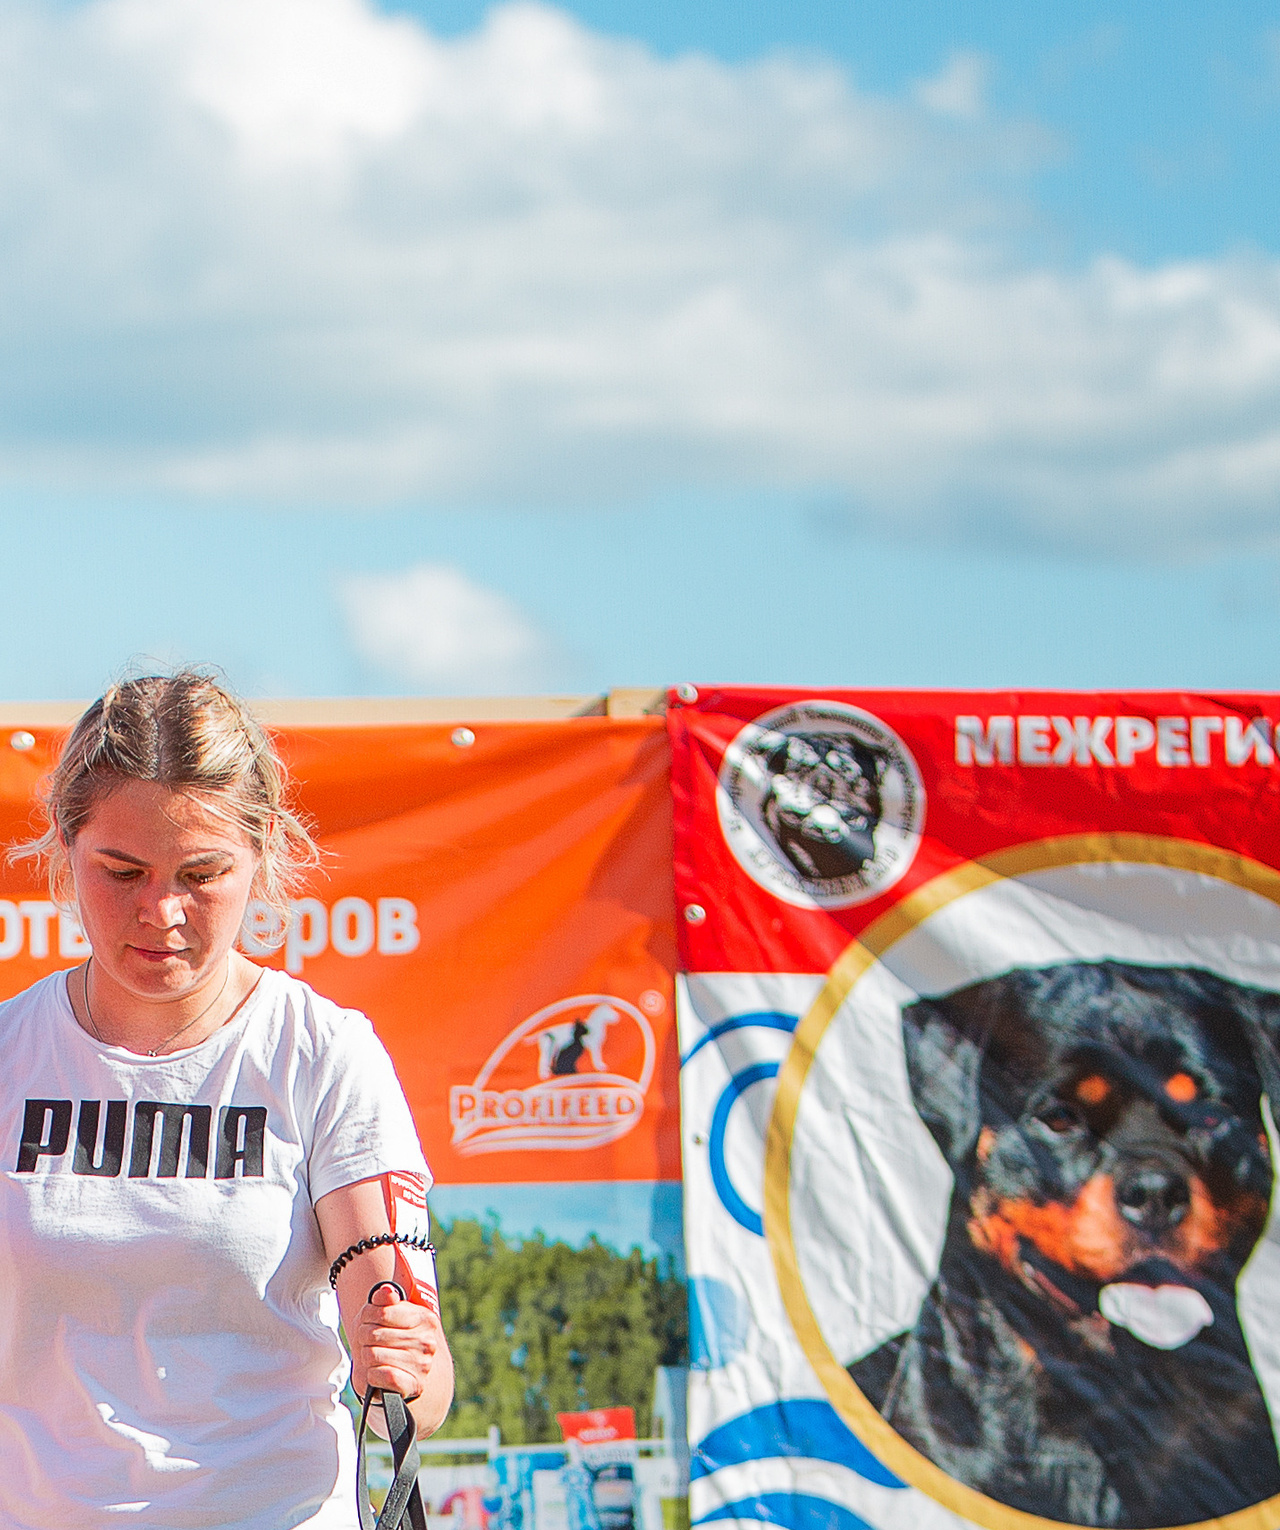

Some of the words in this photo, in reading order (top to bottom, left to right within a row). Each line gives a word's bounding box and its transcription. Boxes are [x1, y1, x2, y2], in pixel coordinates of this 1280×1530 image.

[954, 715, 1280, 768] МЕЖРЕГИ
[457, 1092, 638, 1121] PROFIFEED
[15, 1099, 268, 1179] PUMA
